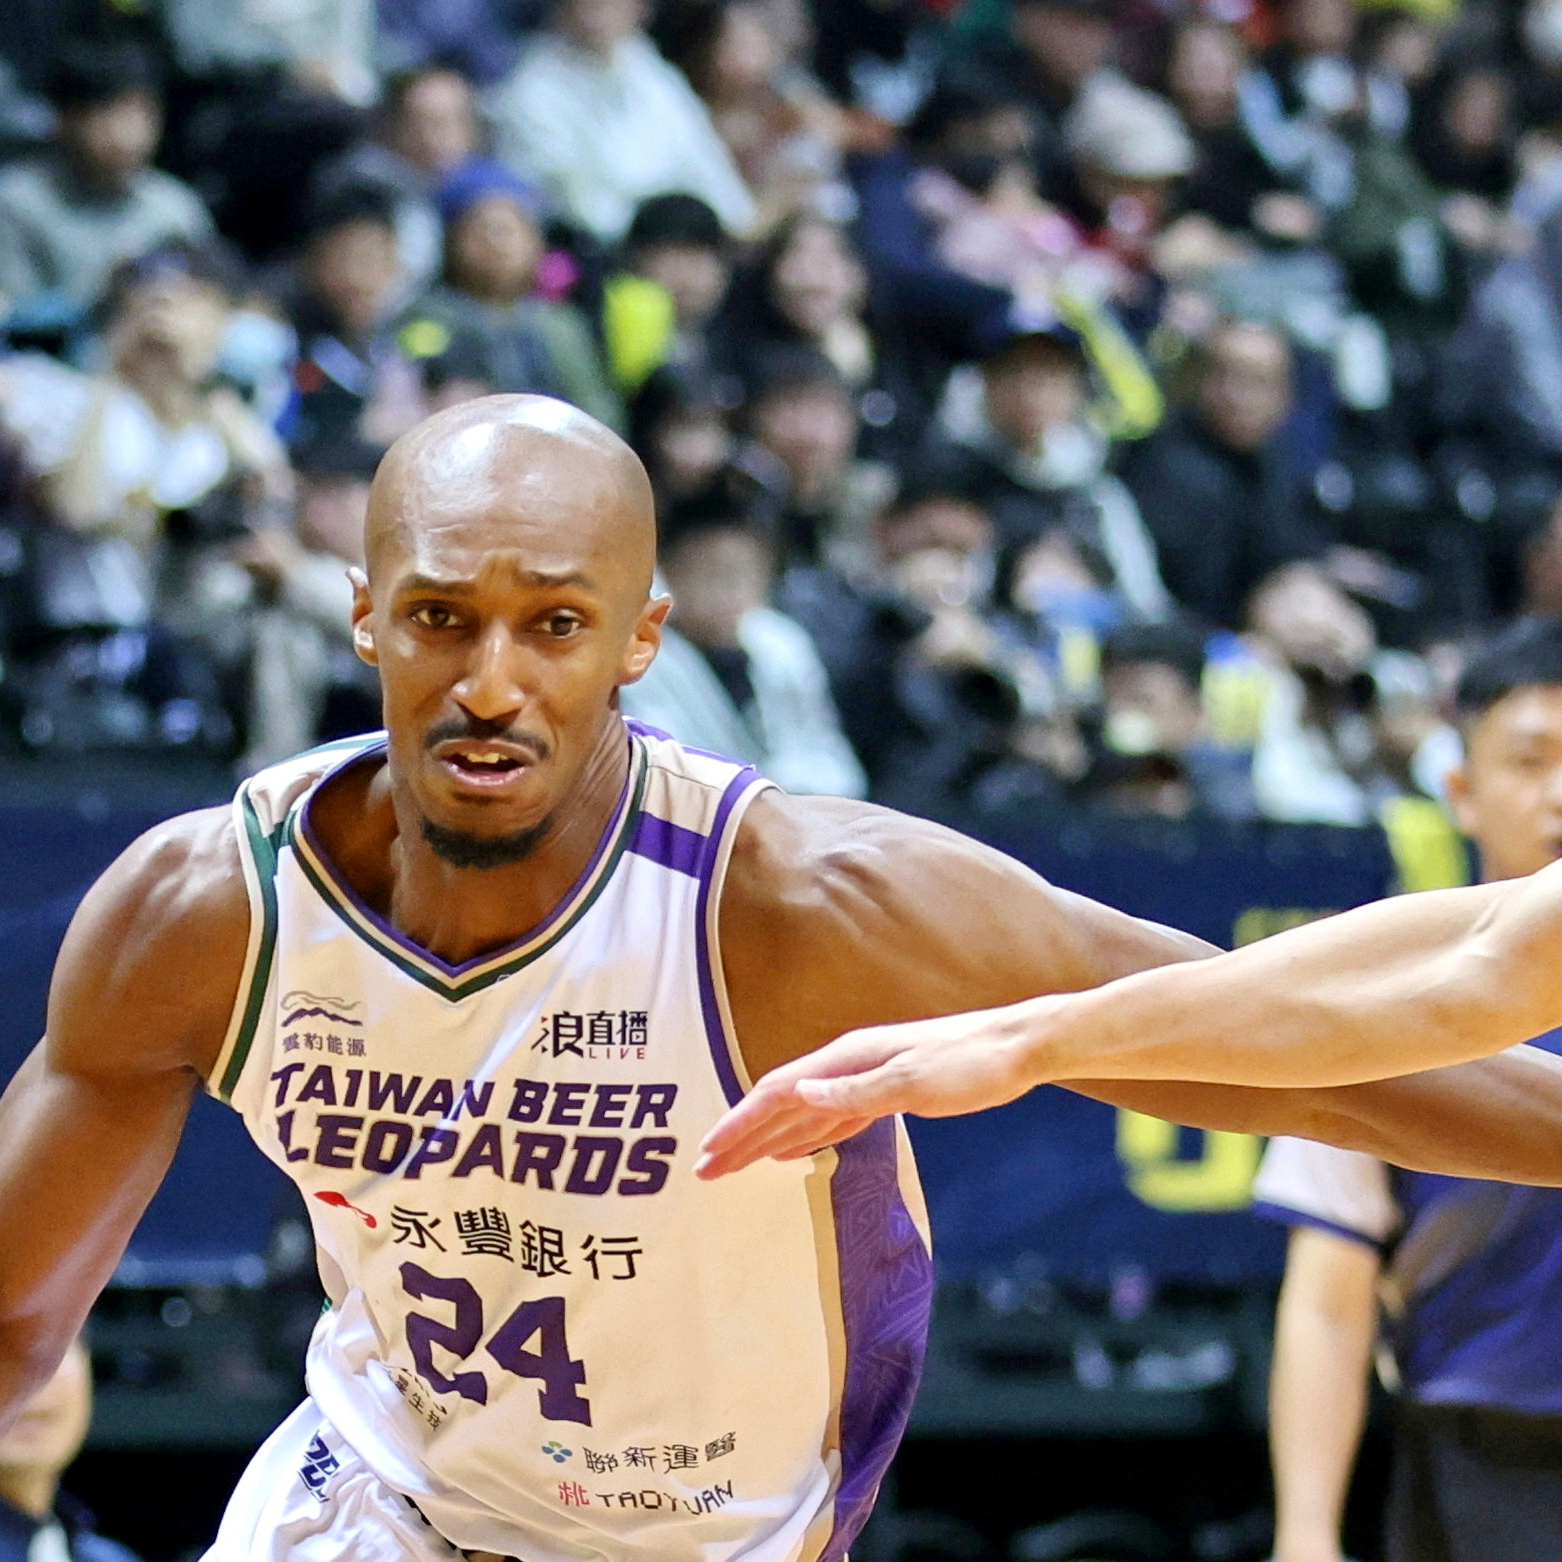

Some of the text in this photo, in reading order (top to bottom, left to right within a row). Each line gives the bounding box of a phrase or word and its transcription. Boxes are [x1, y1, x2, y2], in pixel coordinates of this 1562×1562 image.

[530, 1010, 648, 1058] 浪直播
[588, 1047, 646, 1060] LIVE
[270, 1062, 679, 1130] TAIWAN BEER
[276, 1110, 679, 1197] LEOPARDS
[390, 1205, 643, 1281] 永豐銀行
[398, 1261, 593, 1428] 24
[582, 1432, 736, 1474] 聯新運醫
[595, 1479, 734, 1516] TAOYUAN
